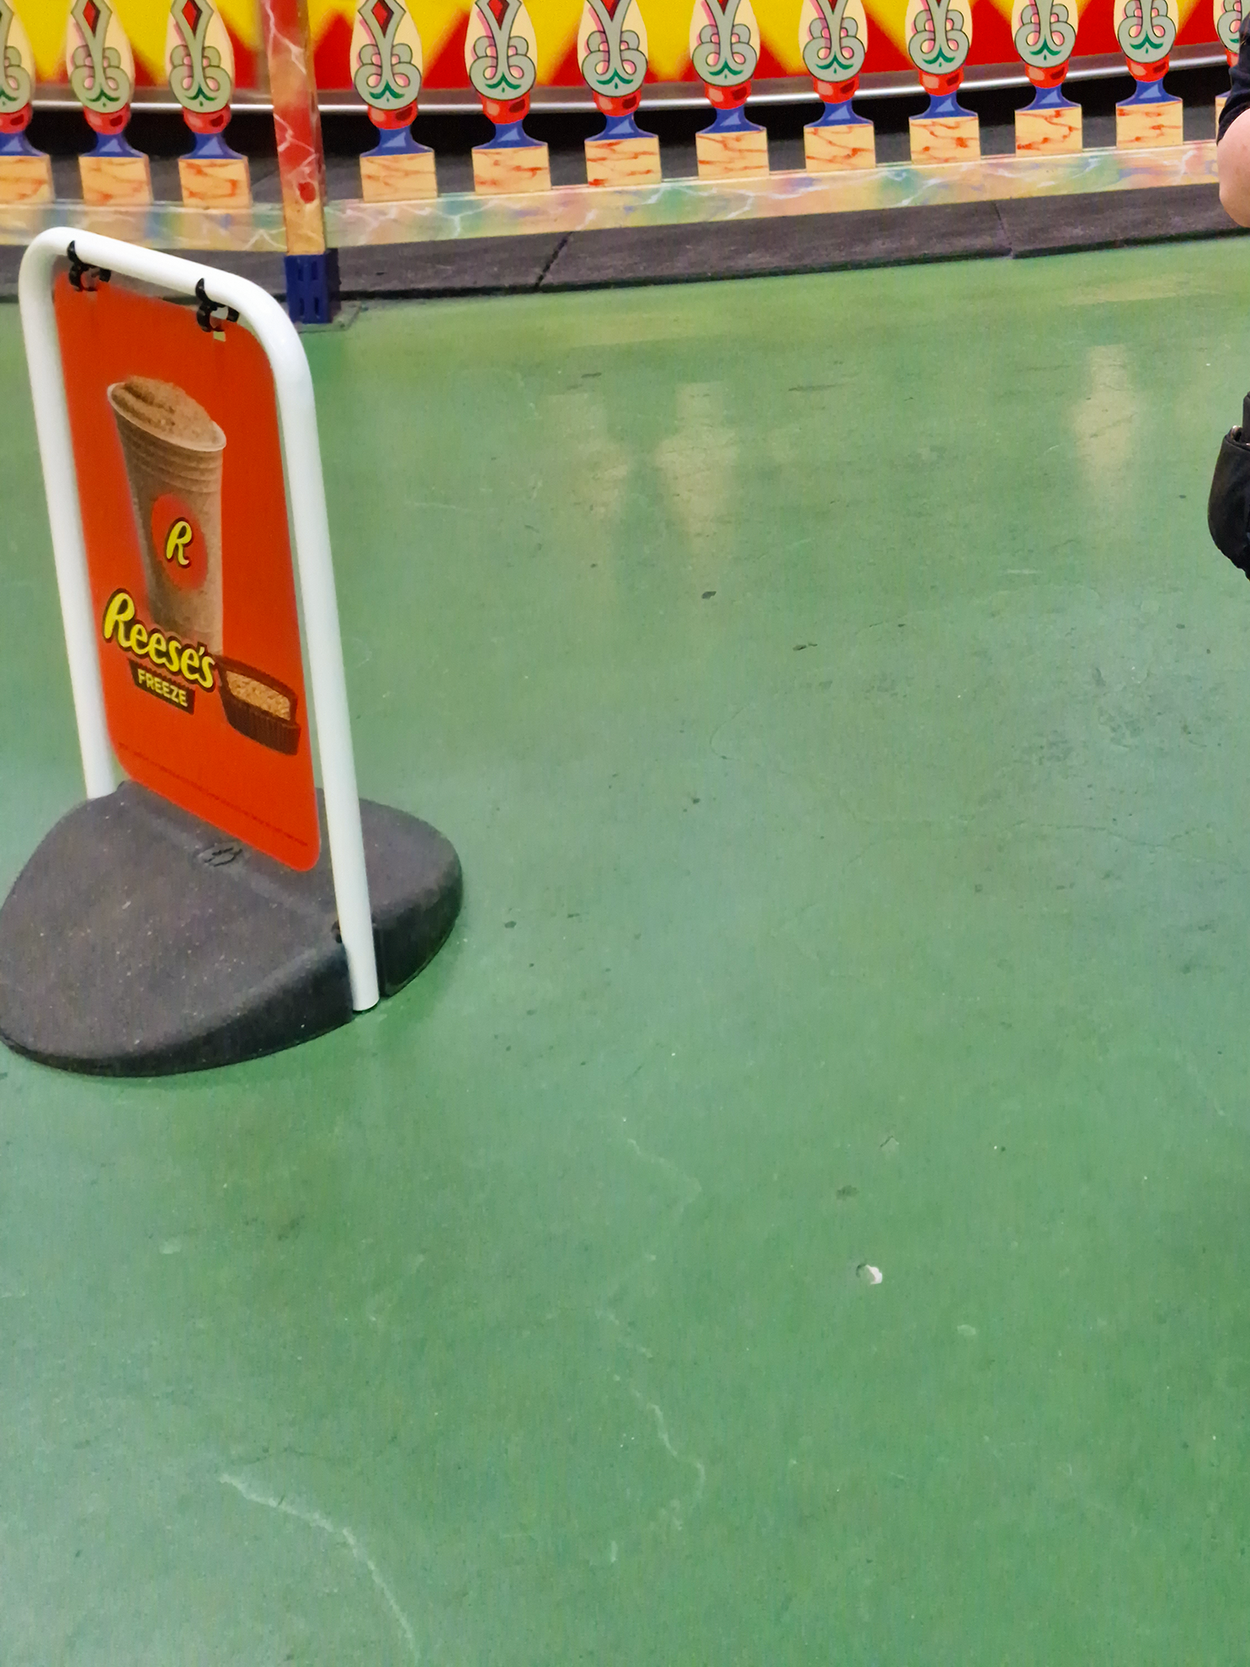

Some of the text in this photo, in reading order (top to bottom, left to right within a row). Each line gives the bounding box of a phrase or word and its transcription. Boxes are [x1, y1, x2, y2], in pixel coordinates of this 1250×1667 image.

[165, 518, 194, 567] R
[103, 590, 215, 690] Reese's
[137, 668, 188, 708] FREEZE
